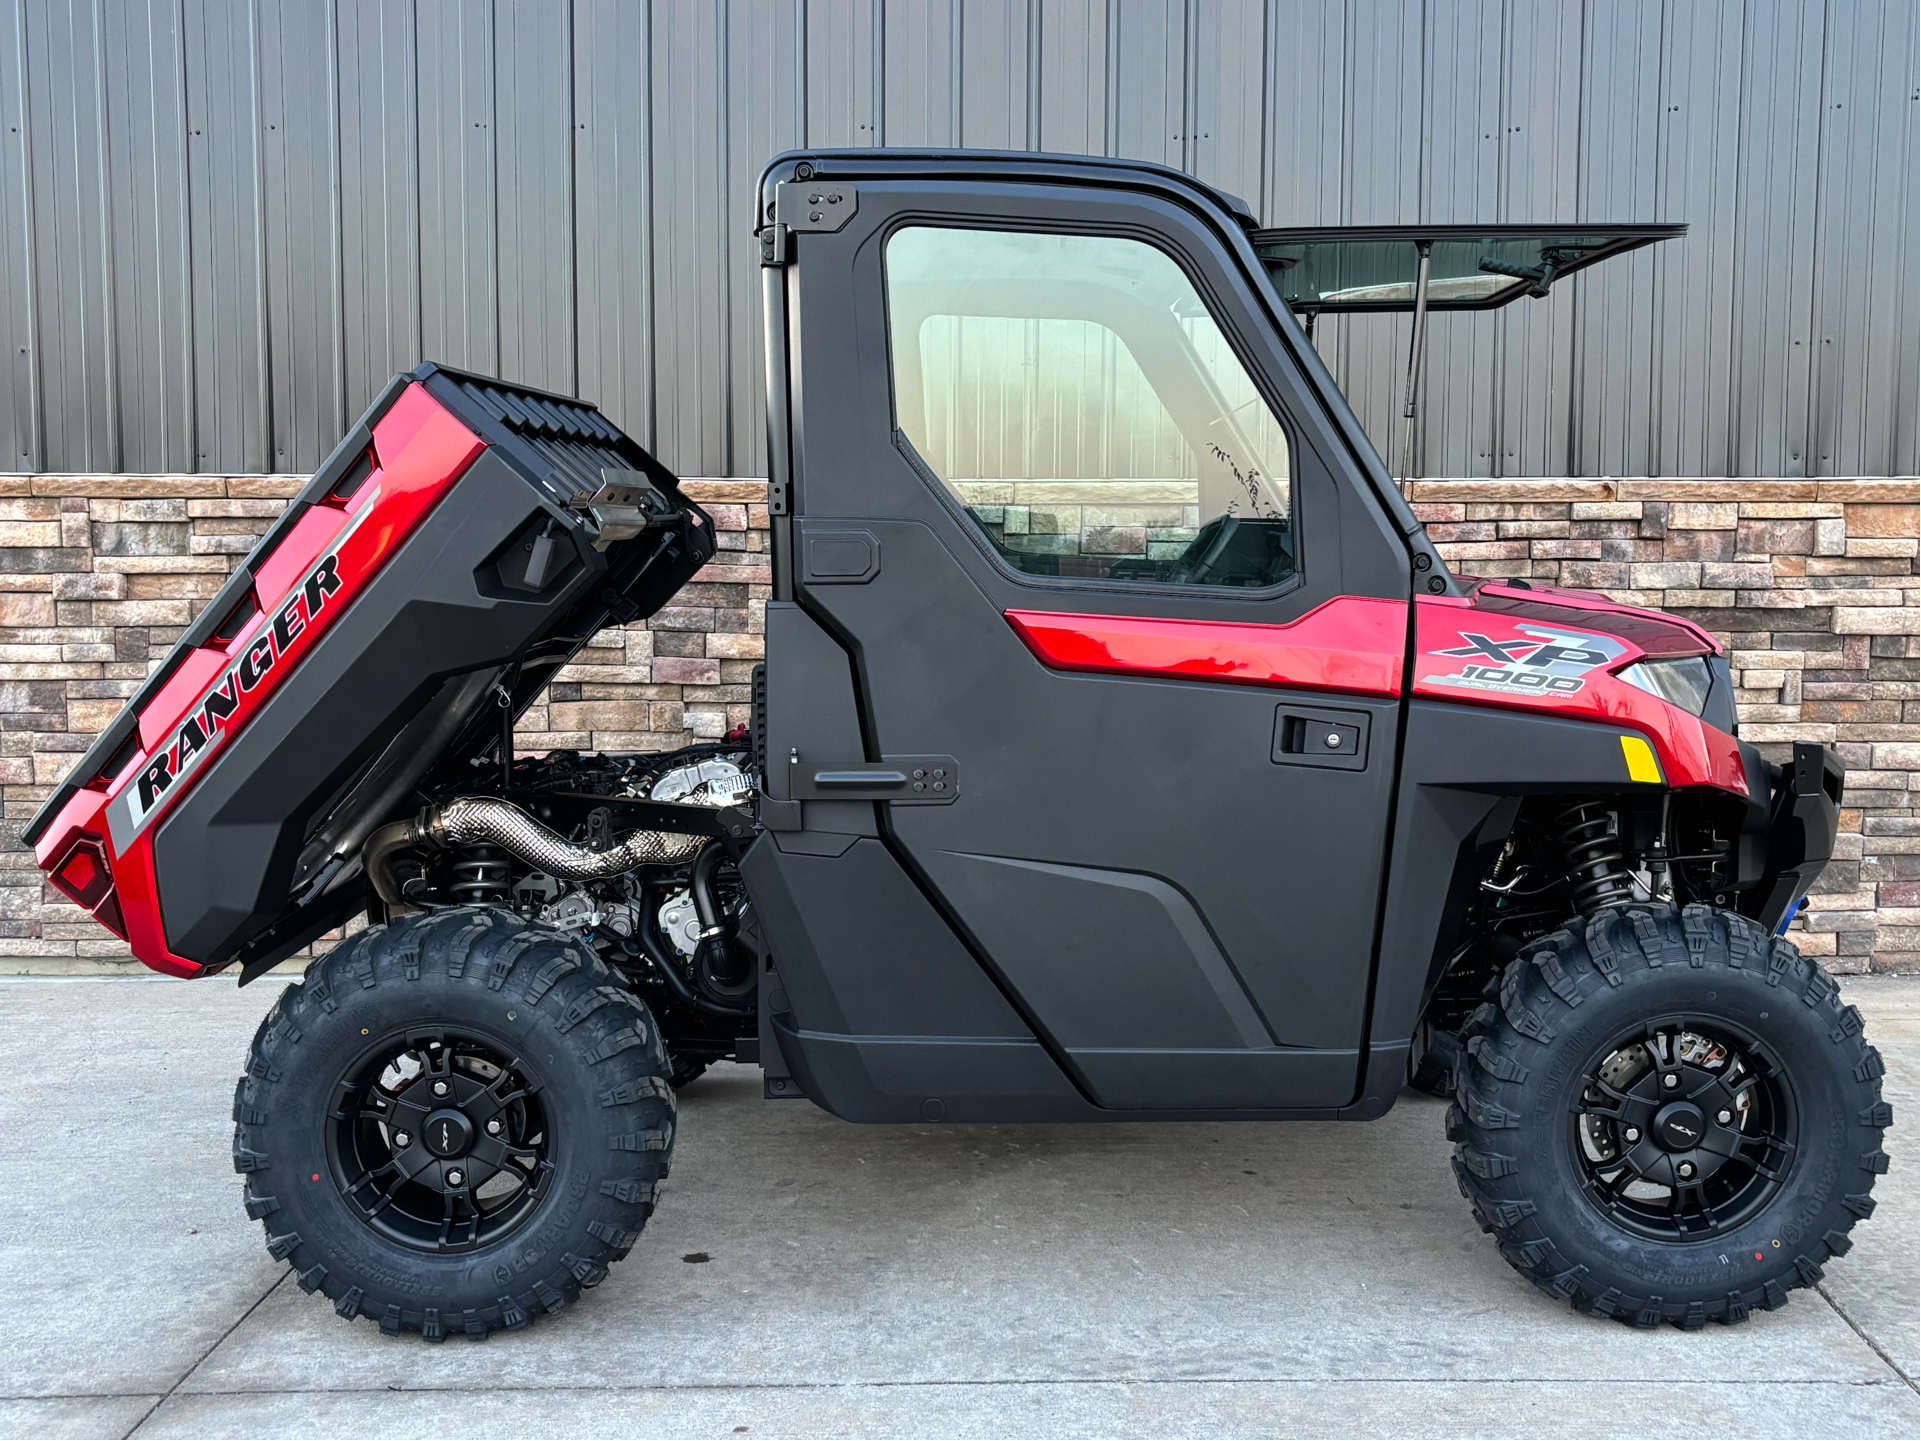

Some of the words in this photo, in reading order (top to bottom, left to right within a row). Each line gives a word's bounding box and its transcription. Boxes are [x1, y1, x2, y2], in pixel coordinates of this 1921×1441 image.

[1427, 631, 1612, 667] XP
[136, 554, 343, 815] RANGER
[1456, 680, 1486, 689] DUAL
[1487, 682, 1548, 696] OVERHEAD
[1548, 691, 1574, 699] CAM
[1461, 664, 1585, 693] 1000
[1669, 1123, 1697, 1137] XP
[512, 1212, 572, 1274] ARMOR
